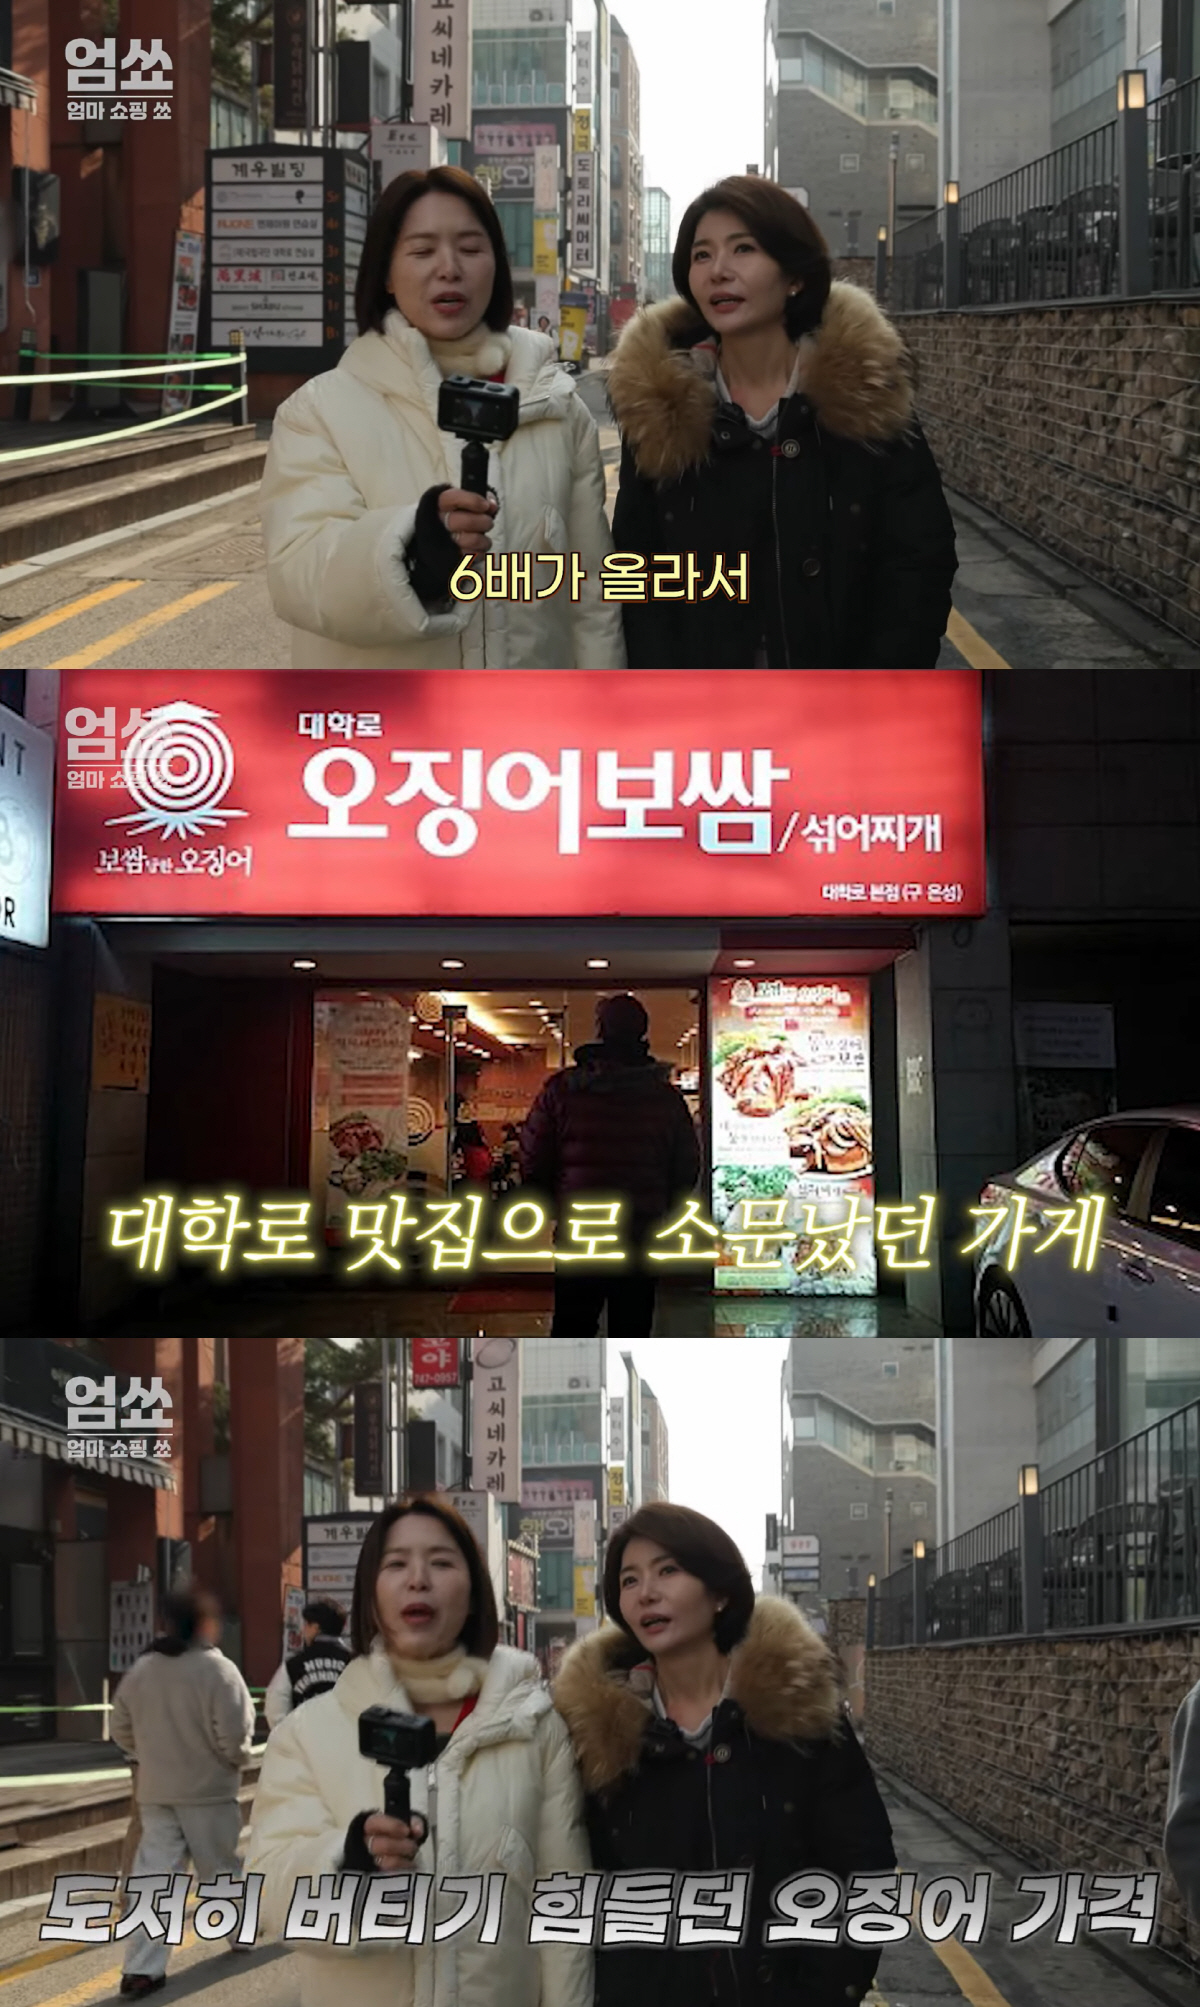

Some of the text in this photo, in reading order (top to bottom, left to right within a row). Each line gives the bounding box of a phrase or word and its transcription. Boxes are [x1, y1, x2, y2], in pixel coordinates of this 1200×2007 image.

[231, 161, 305, 178] 계우빌딩
[576, 157, 591, 263] 도토리씨어터
[298, 710, 384, 740] 대학로
[286, 745, 791, 858] 오징어보쌈
[174, 845, 253, 877] 오징어
[822, 882, 964, 903] 대학로 본점 (구 은성)
[487, 1376, 507, 1493] 고씨네카레
[323, 1525, 369, 1540] 계우빌
[303, 1656, 346, 1672] MUSIC
